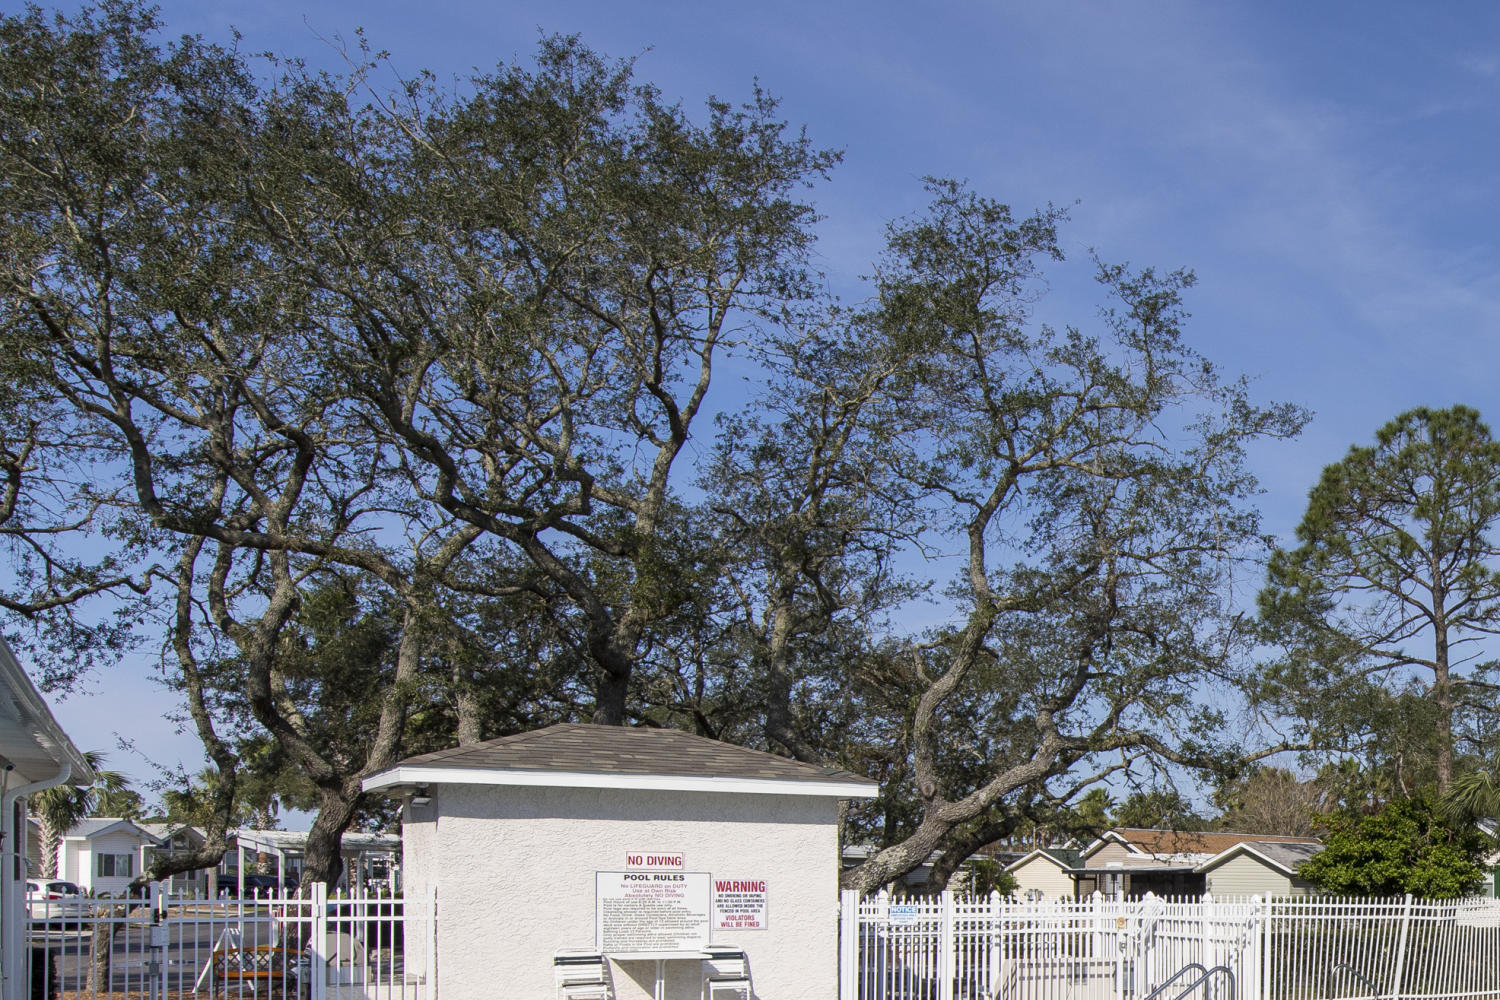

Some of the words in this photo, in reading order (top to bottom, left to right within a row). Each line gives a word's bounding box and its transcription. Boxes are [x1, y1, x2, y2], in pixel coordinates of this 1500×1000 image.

[628, 855, 643, 866] NO
[647, 856, 682, 866] DIVING
[715, 880, 766, 892] WARNING
